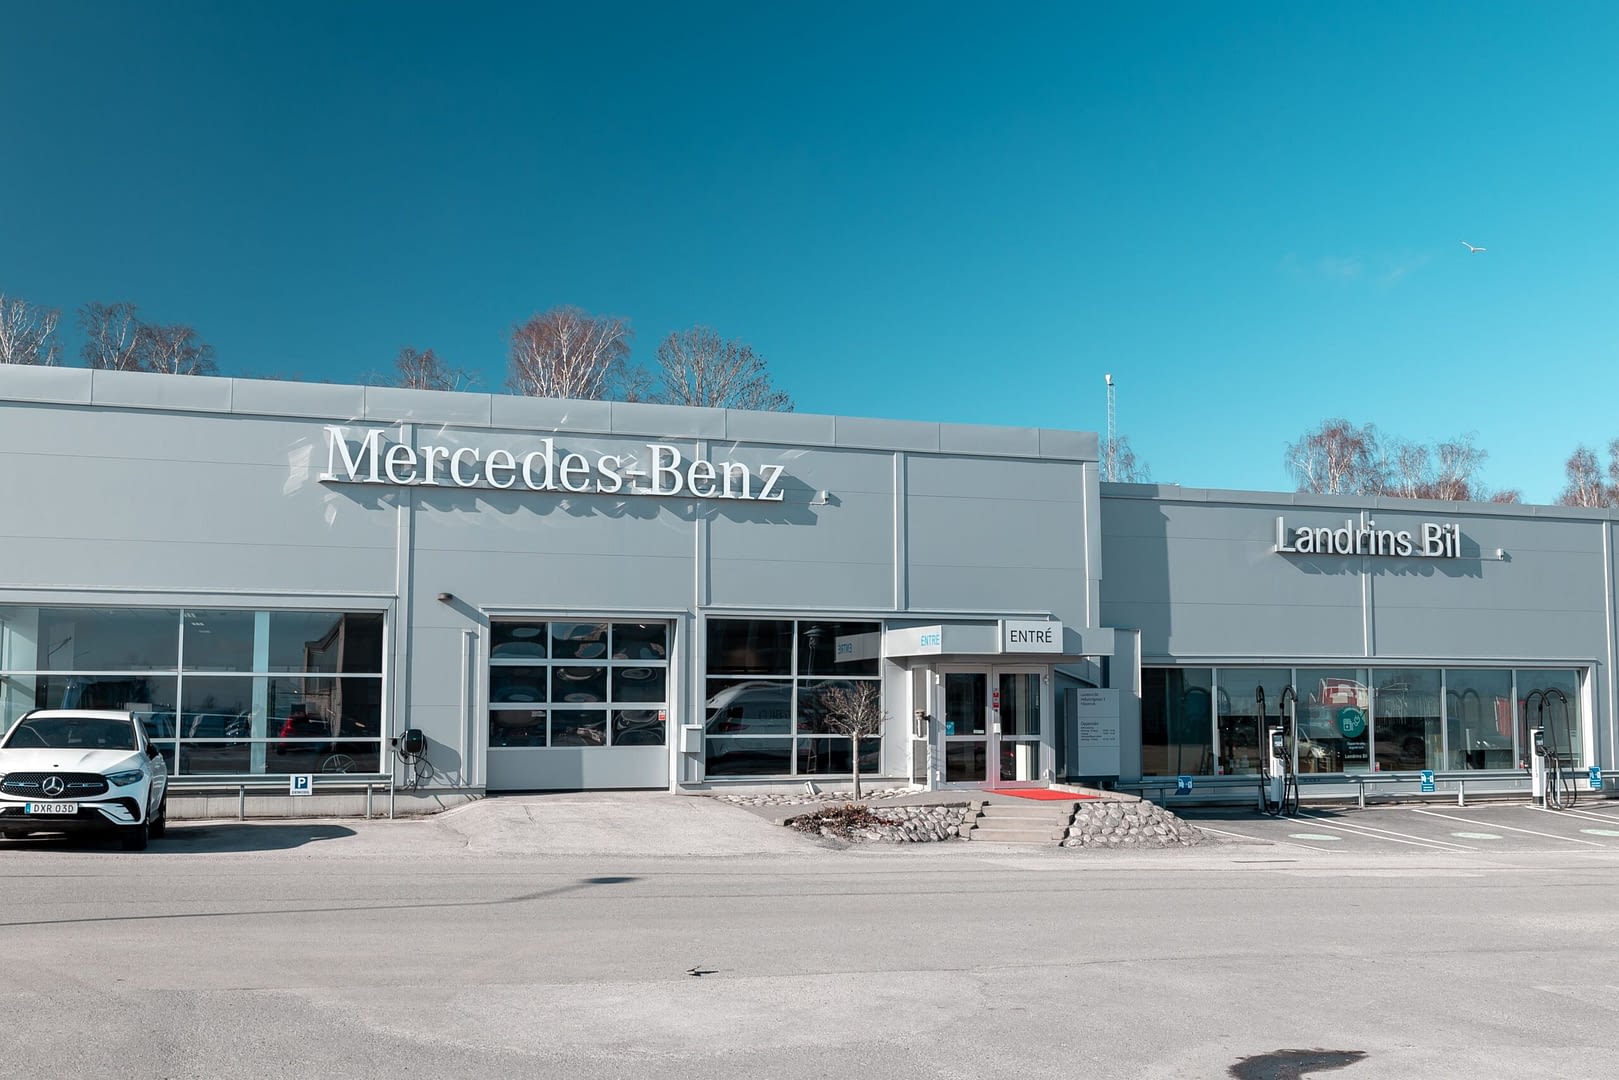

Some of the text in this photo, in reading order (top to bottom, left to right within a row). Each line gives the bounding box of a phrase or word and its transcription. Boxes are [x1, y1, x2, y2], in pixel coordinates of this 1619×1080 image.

[320, 426, 785, 501] Mercedes-Benz
[1275, 516, 1461, 558] Landrins Bil
[1010, 627, 1053, 643] ENTRÉ
[297, 777, 306, 788] P
[33, 804, 52, 813] DXR
